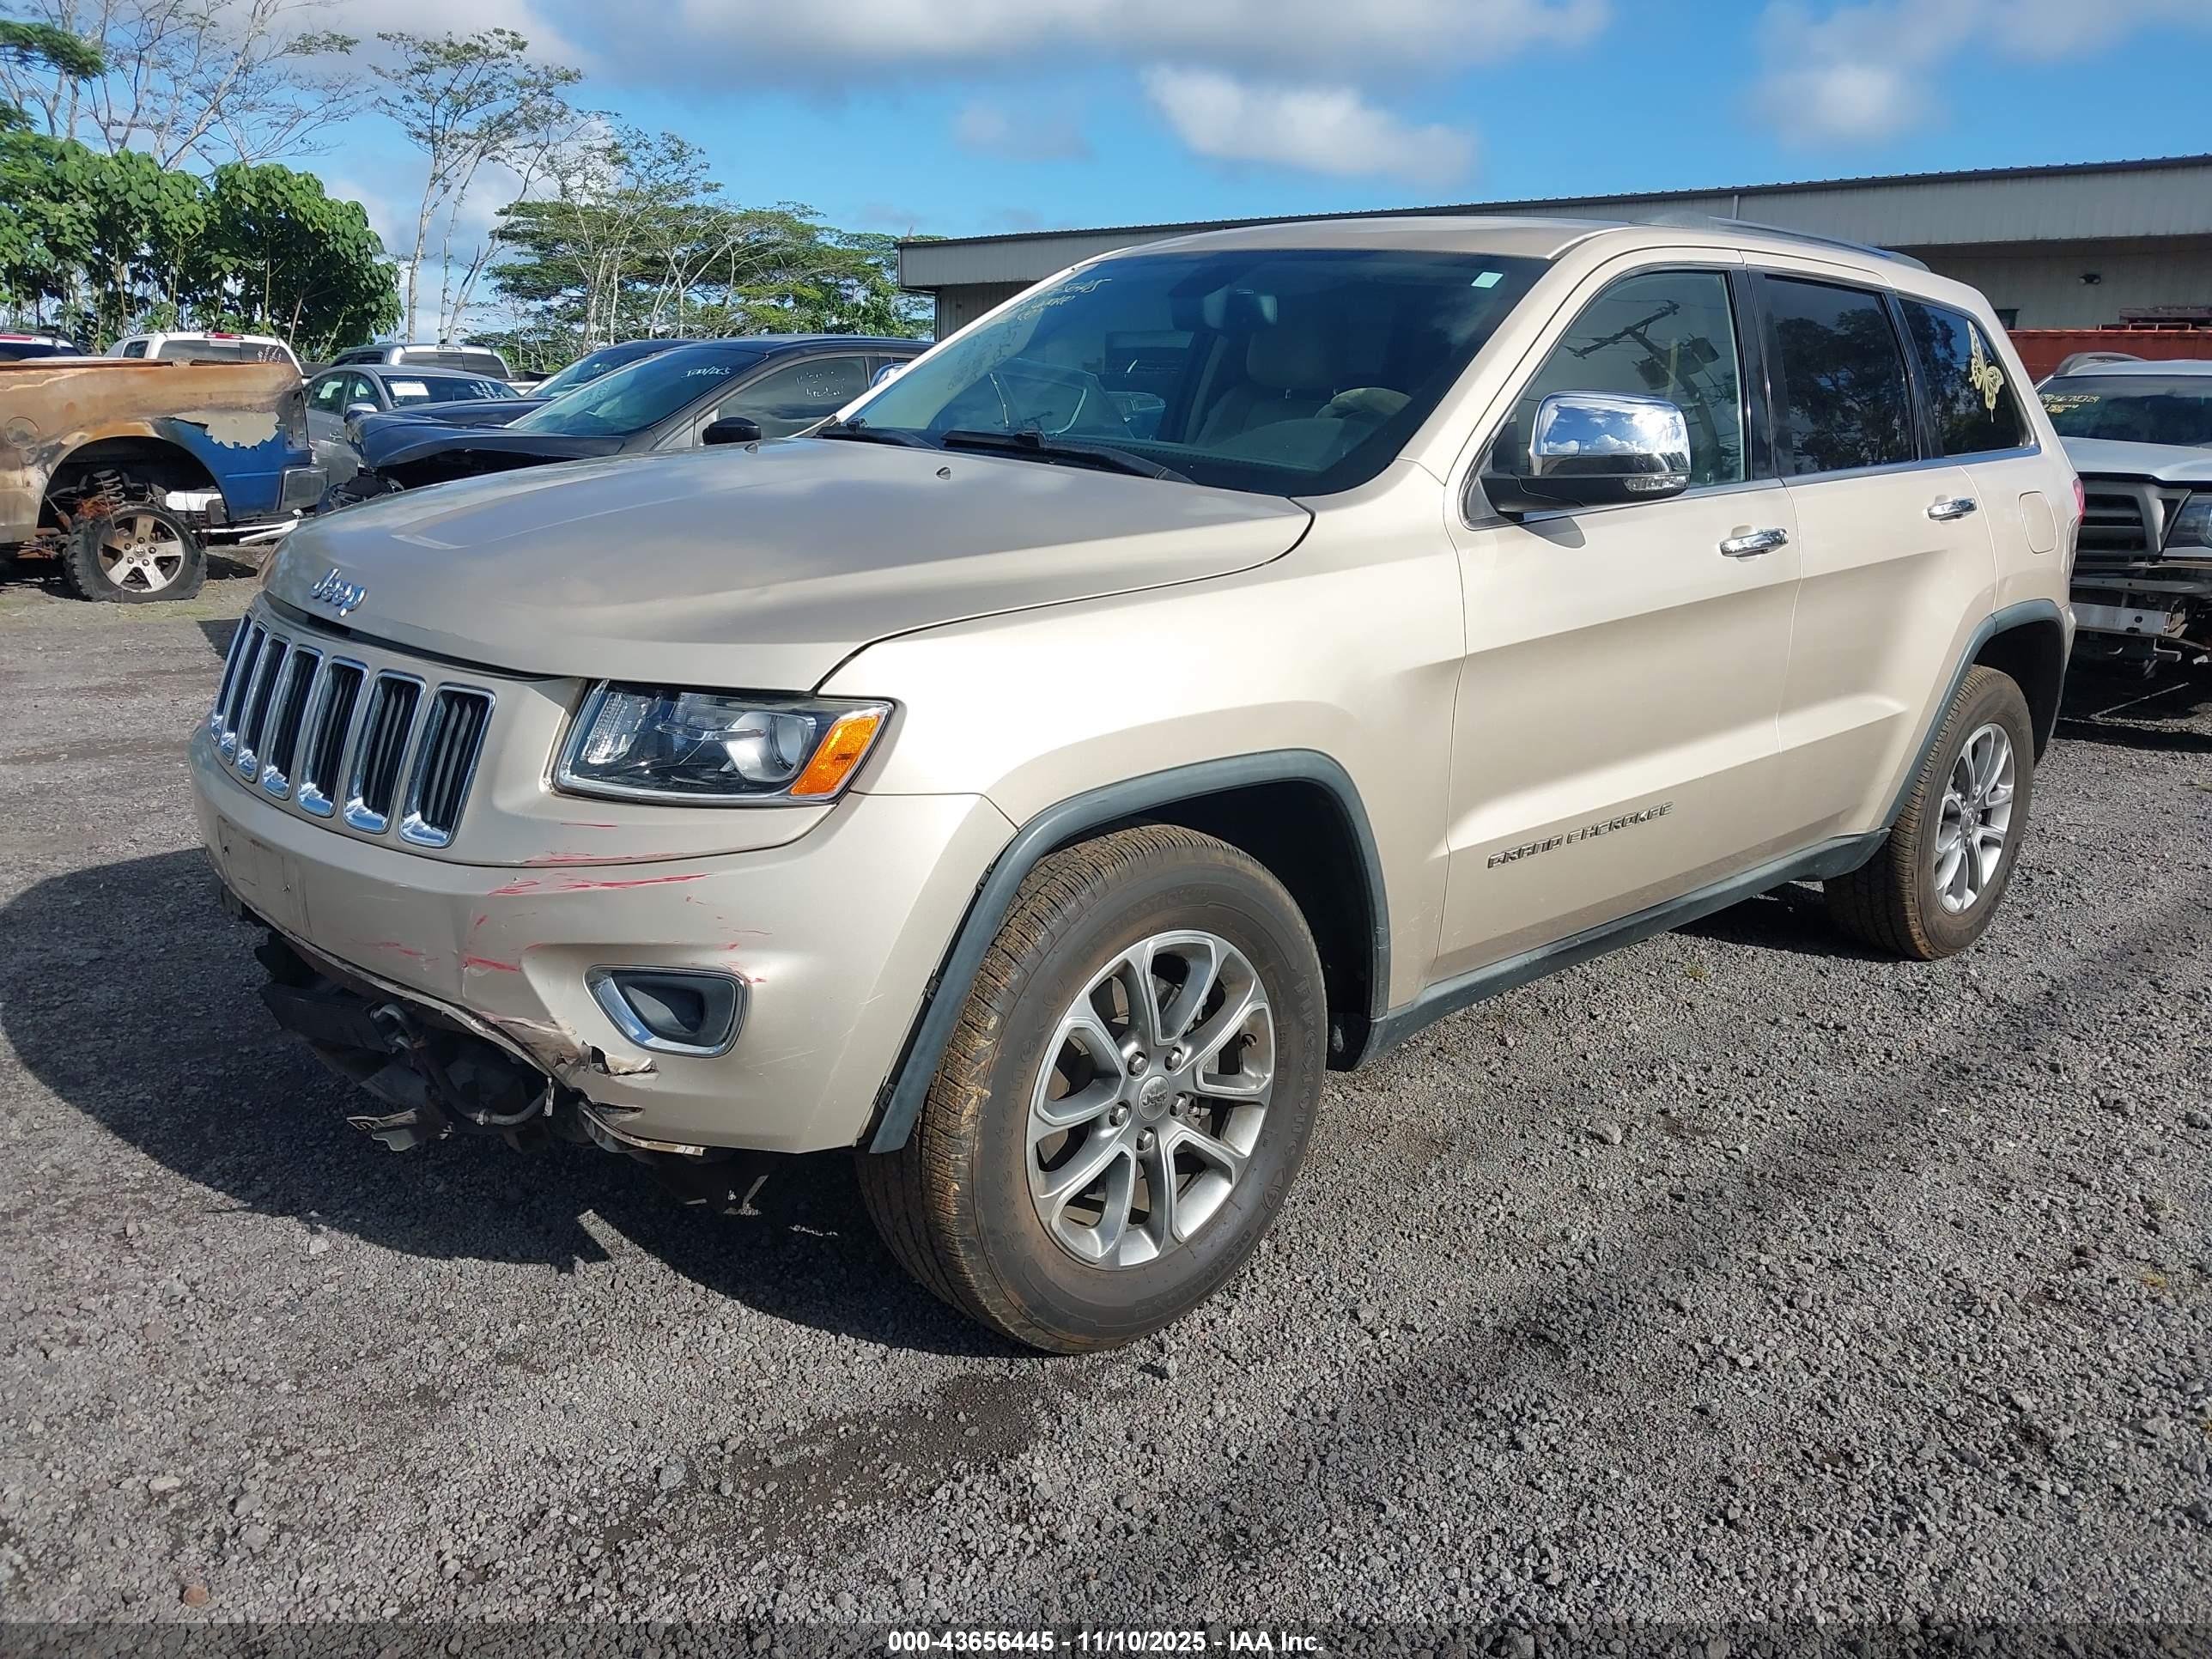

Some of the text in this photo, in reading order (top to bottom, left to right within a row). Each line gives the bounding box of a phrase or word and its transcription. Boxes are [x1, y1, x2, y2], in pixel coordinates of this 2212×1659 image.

[310, 568, 367, 617] Jeep
[1487, 801, 1674, 869] GRAND CHEROKEE
[1142, 1091, 1168, 1107] Jeep
